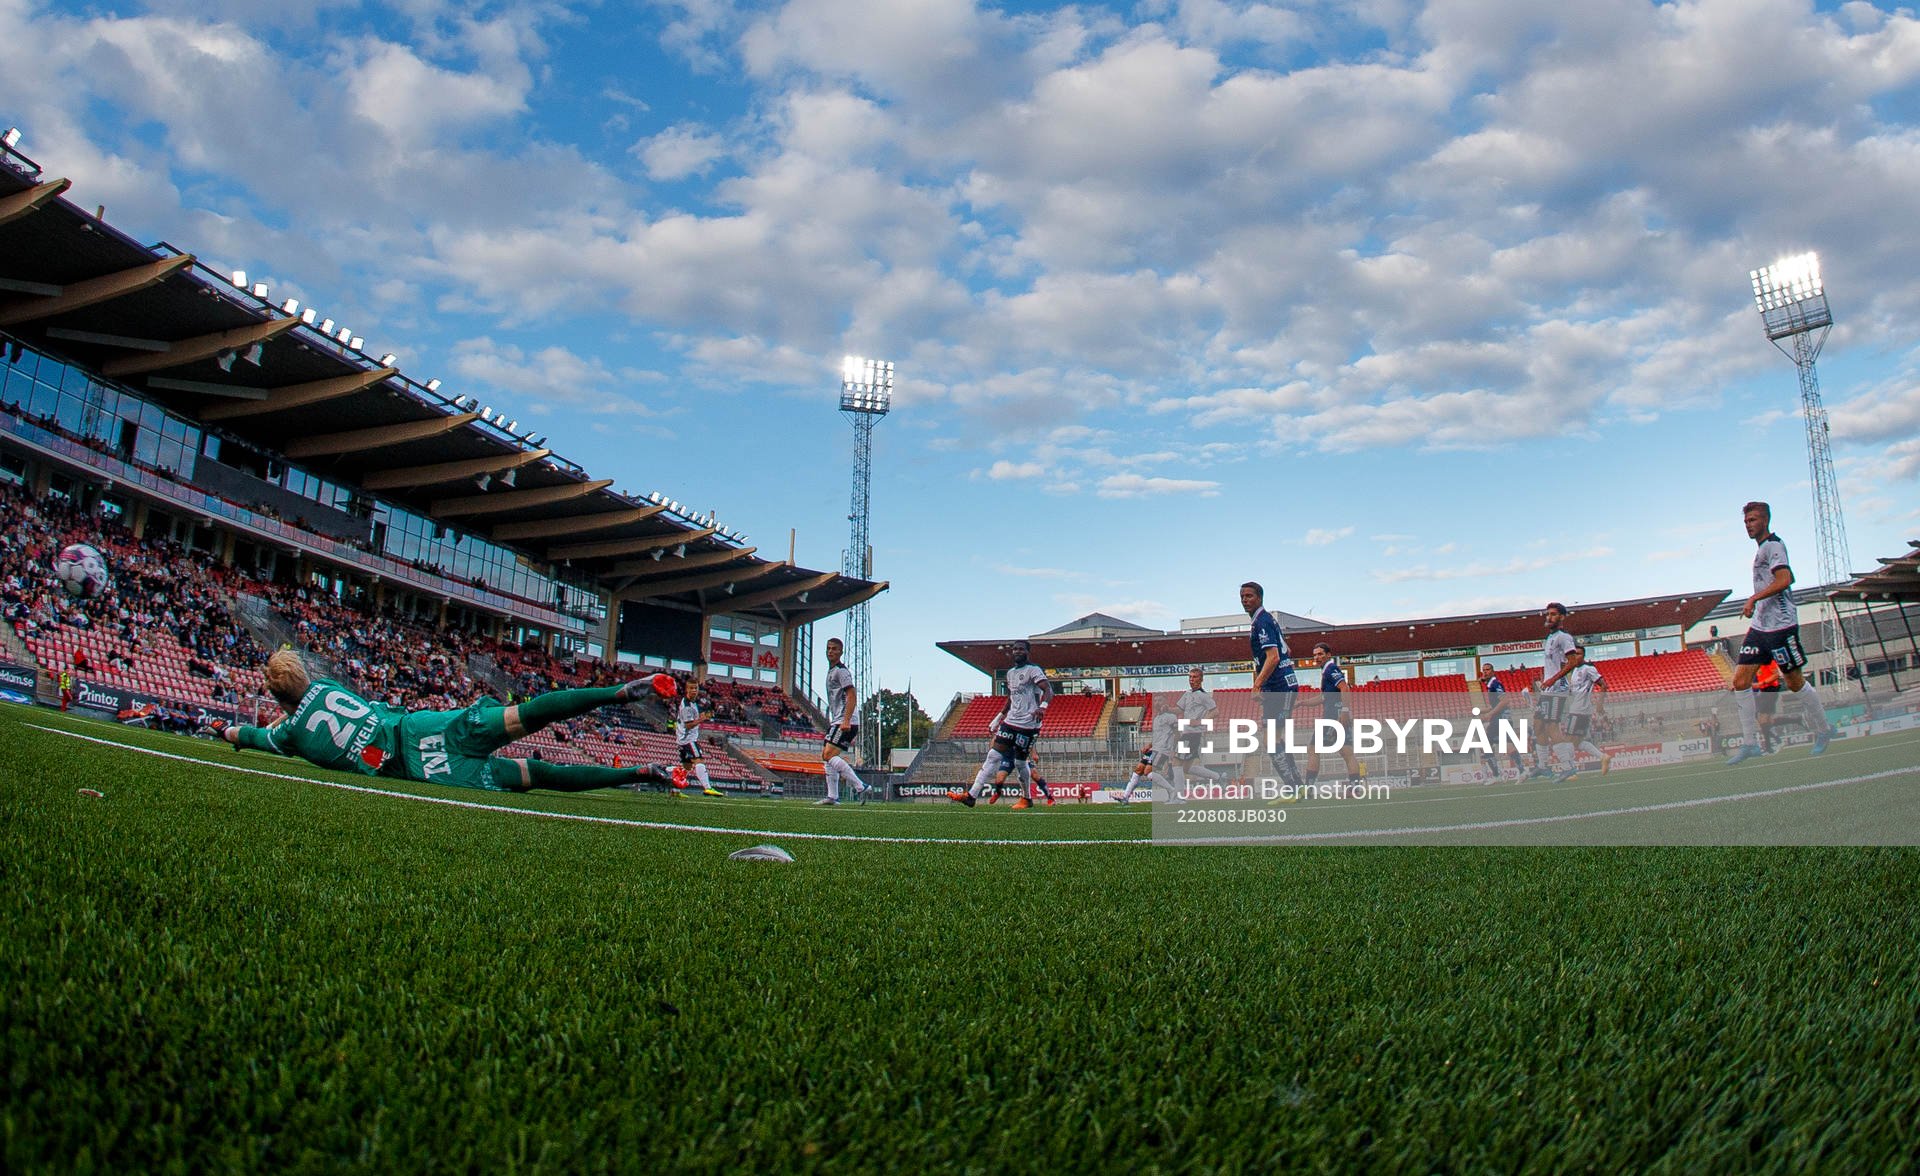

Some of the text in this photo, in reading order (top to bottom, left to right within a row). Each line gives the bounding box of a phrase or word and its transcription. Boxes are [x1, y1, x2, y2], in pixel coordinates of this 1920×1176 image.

[79, 683, 118, 707] Printoz
[305, 691, 371, 749] 20
[899, 784, 964, 797] tsreklamse
